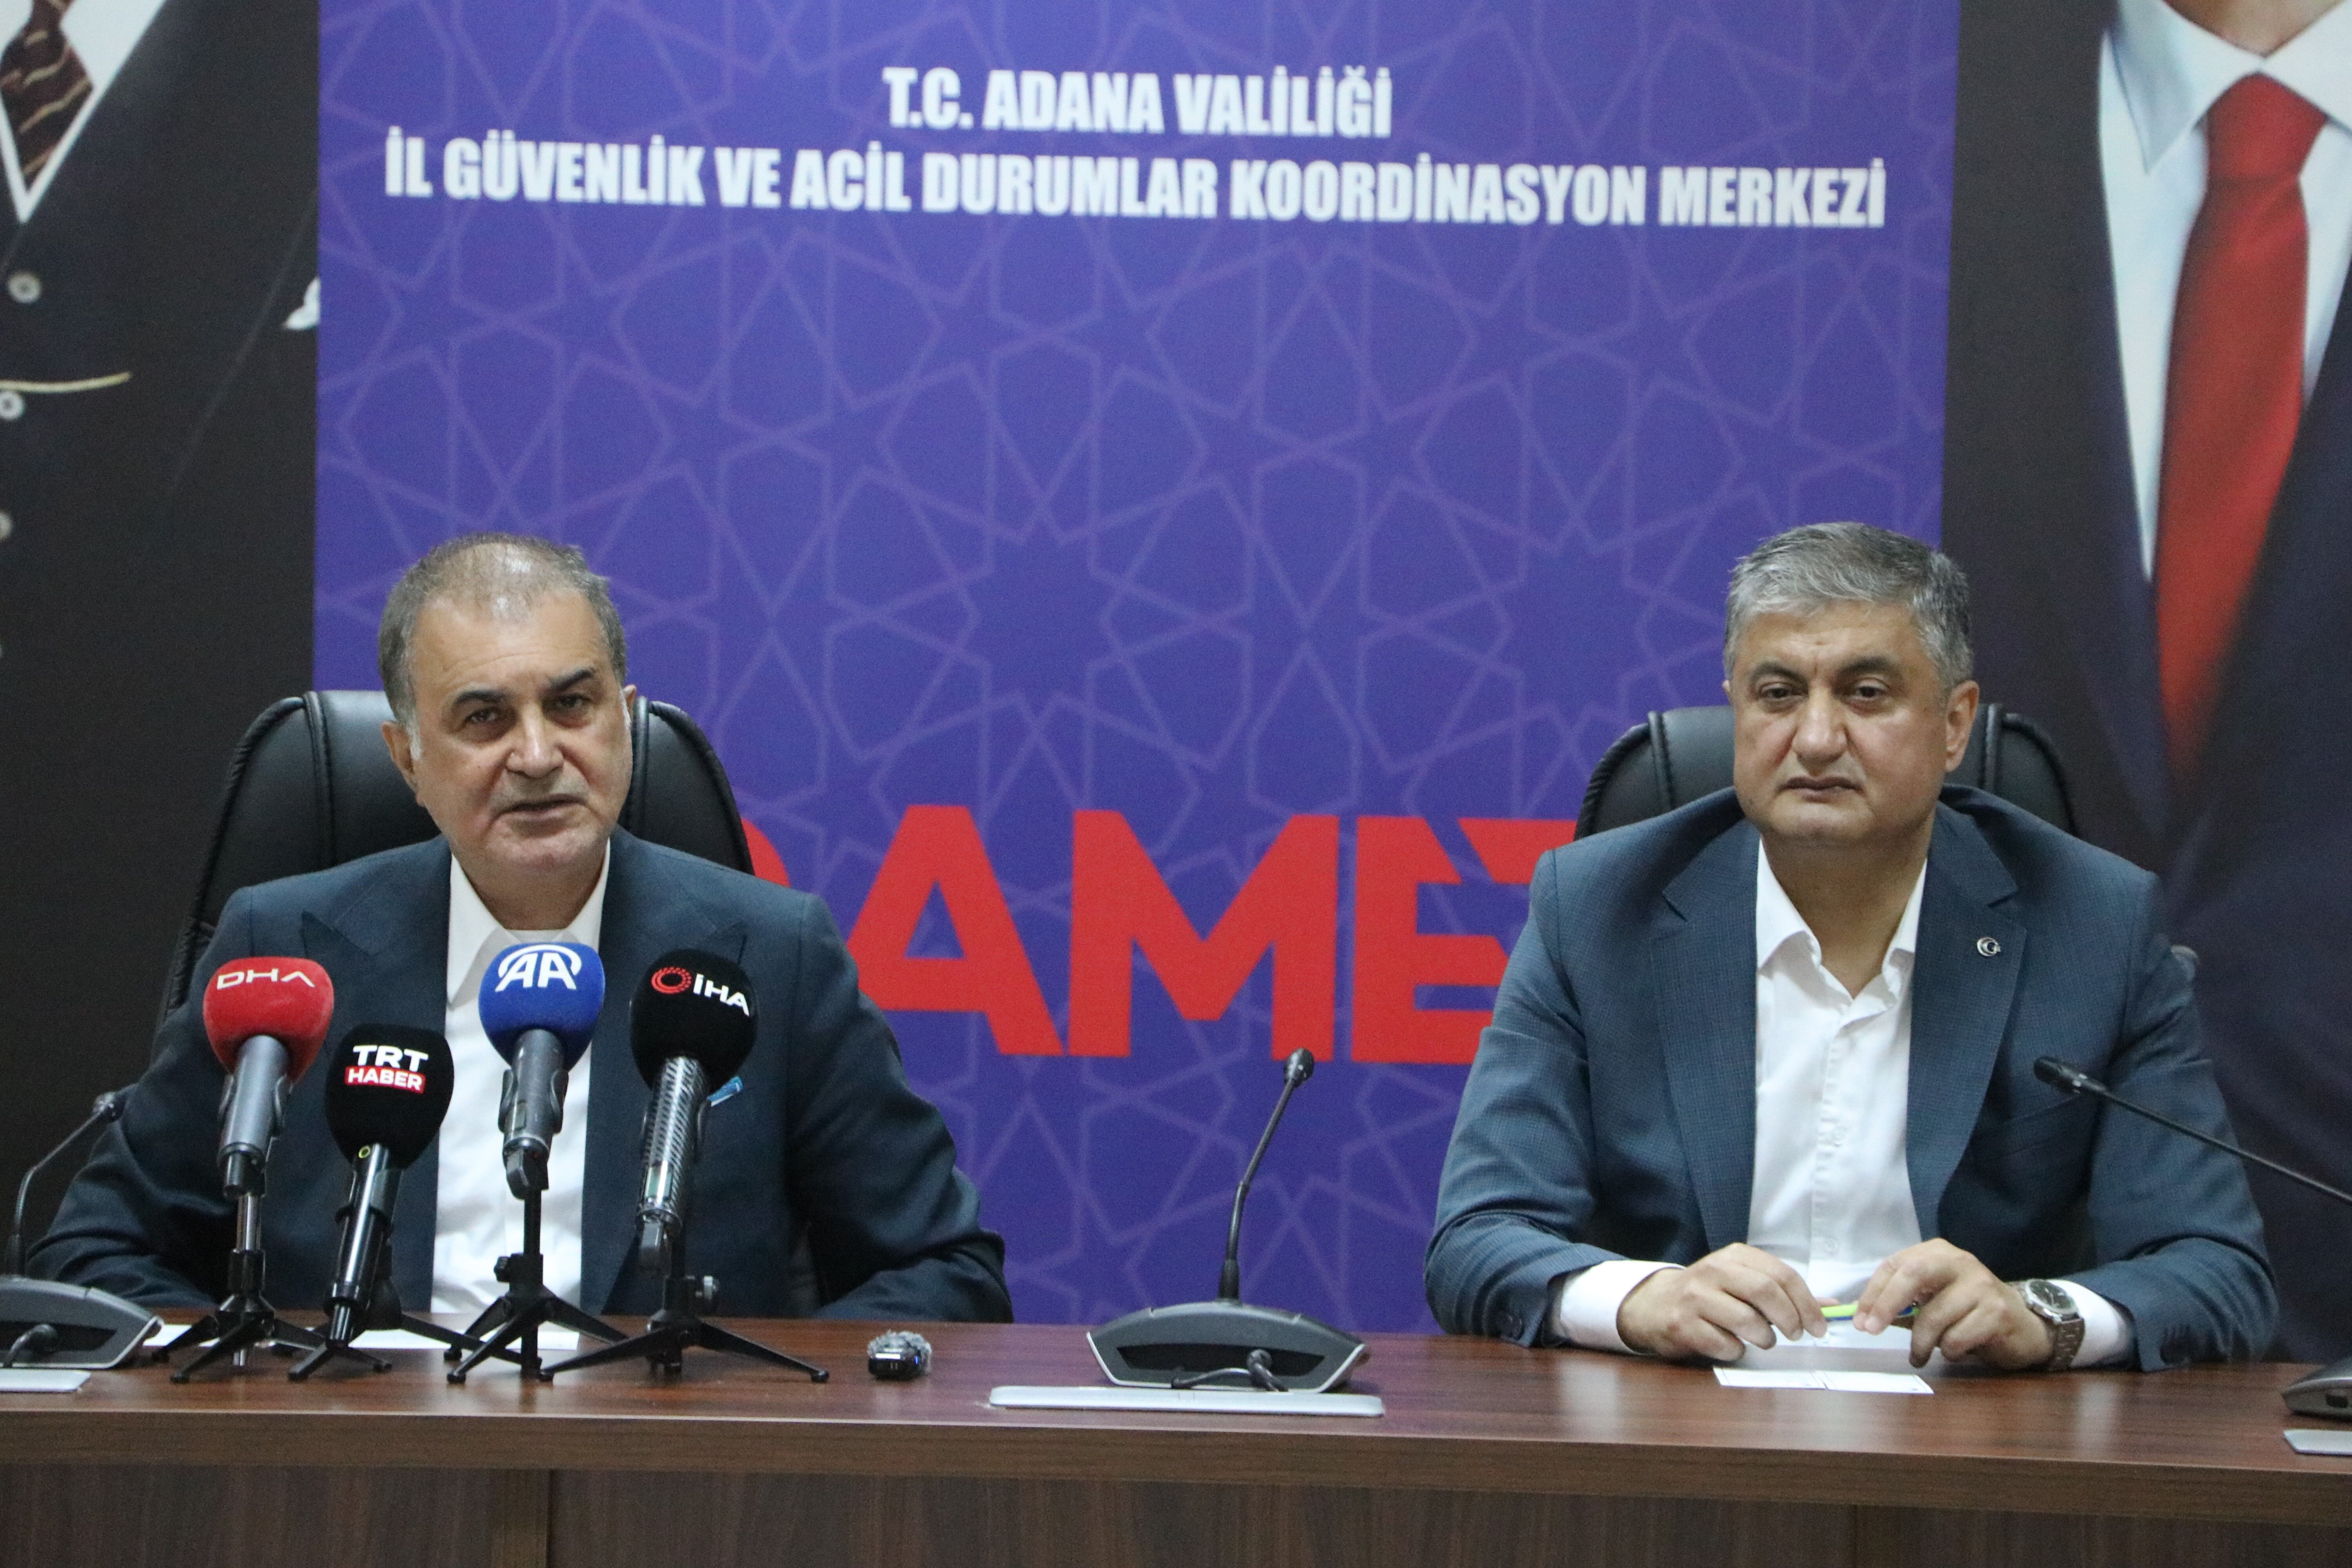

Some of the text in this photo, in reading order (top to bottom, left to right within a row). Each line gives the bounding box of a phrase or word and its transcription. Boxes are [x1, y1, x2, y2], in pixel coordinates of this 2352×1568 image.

[882, 65, 1392, 138] T.C. ADANA VALİLİĞİ
[385, 126, 1886, 227] İL GÜVENLİK VE ACİL DURUMLAR KOORDİNASYON MERKEZİ
[740, 804, 1577, 1065] AME
[216, 968, 315, 990] DHA
[494, 951, 578, 993] AA
[348, 1067, 423, 1091] HABER
[353, 1044, 429, 1073] TRT
